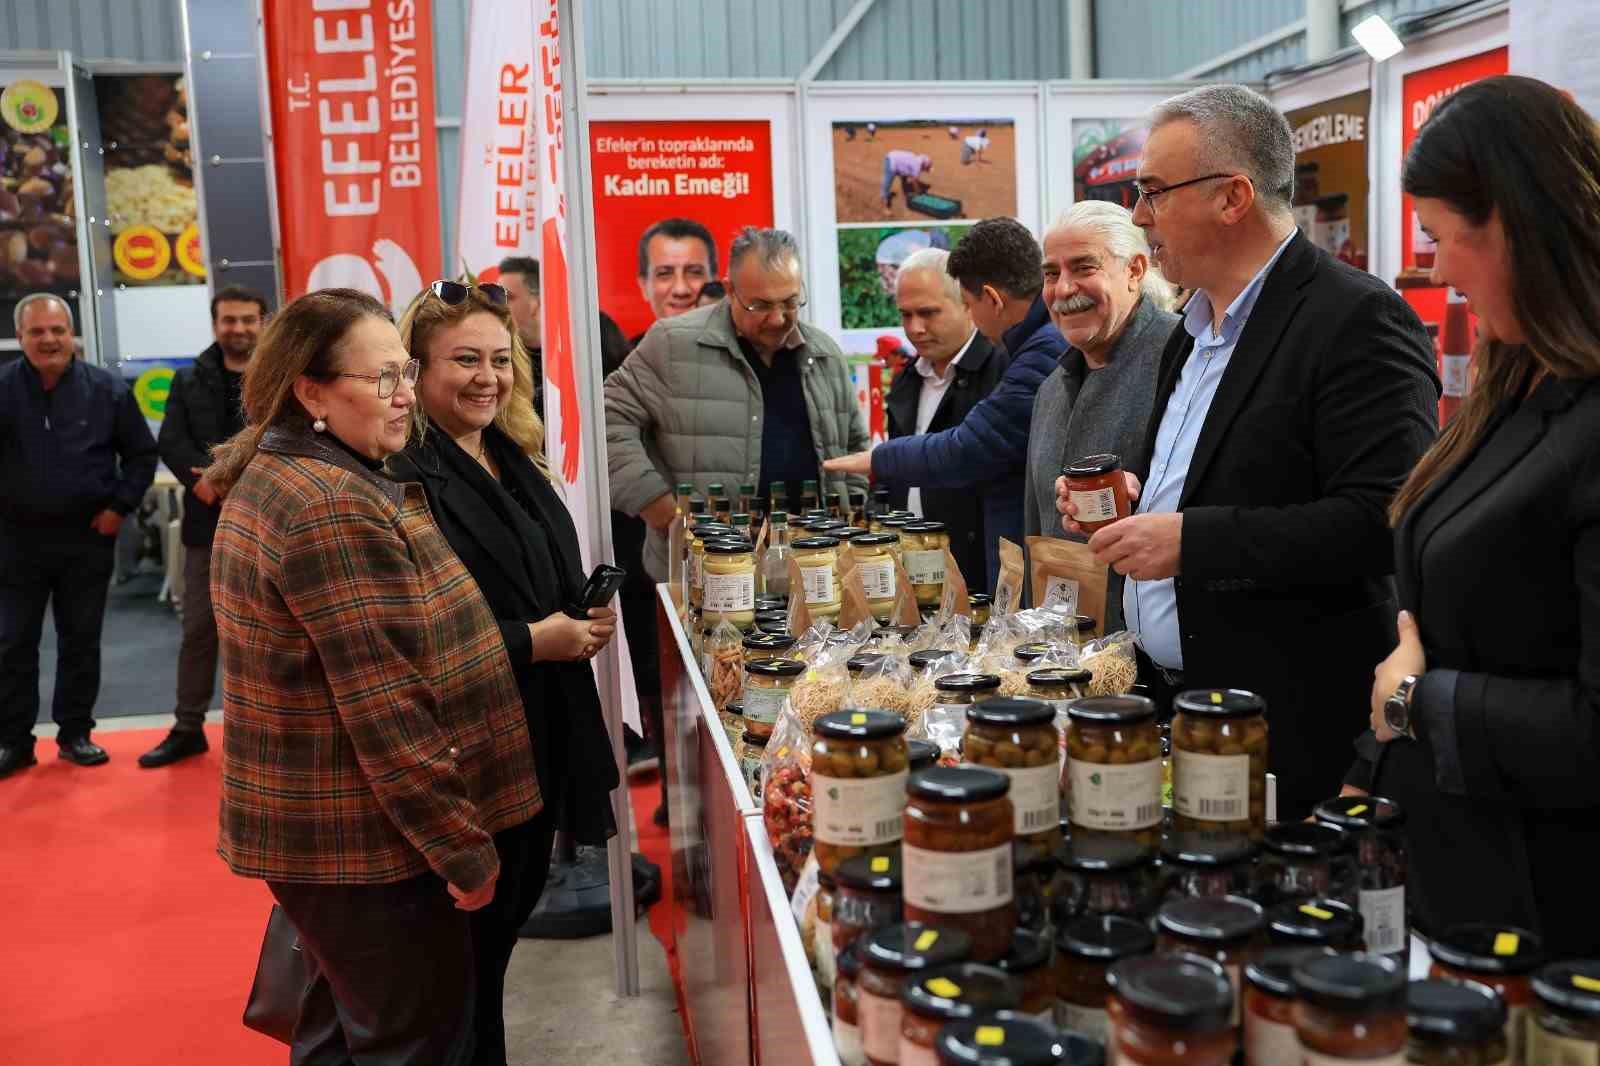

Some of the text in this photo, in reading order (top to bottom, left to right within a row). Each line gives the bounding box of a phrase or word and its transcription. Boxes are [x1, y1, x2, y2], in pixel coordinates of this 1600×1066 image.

[287, 72, 310, 112] T.C.
[312, 0, 381, 217] EFELE
[658, 136, 754, 155] topraklarında
[1291, 114, 1364, 152] EKERLEME
[496, 63, 529, 248] EFELER
[627, 154, 696, 170] bereketin
[604, 172, 749, 199] Kadın Emeği!
